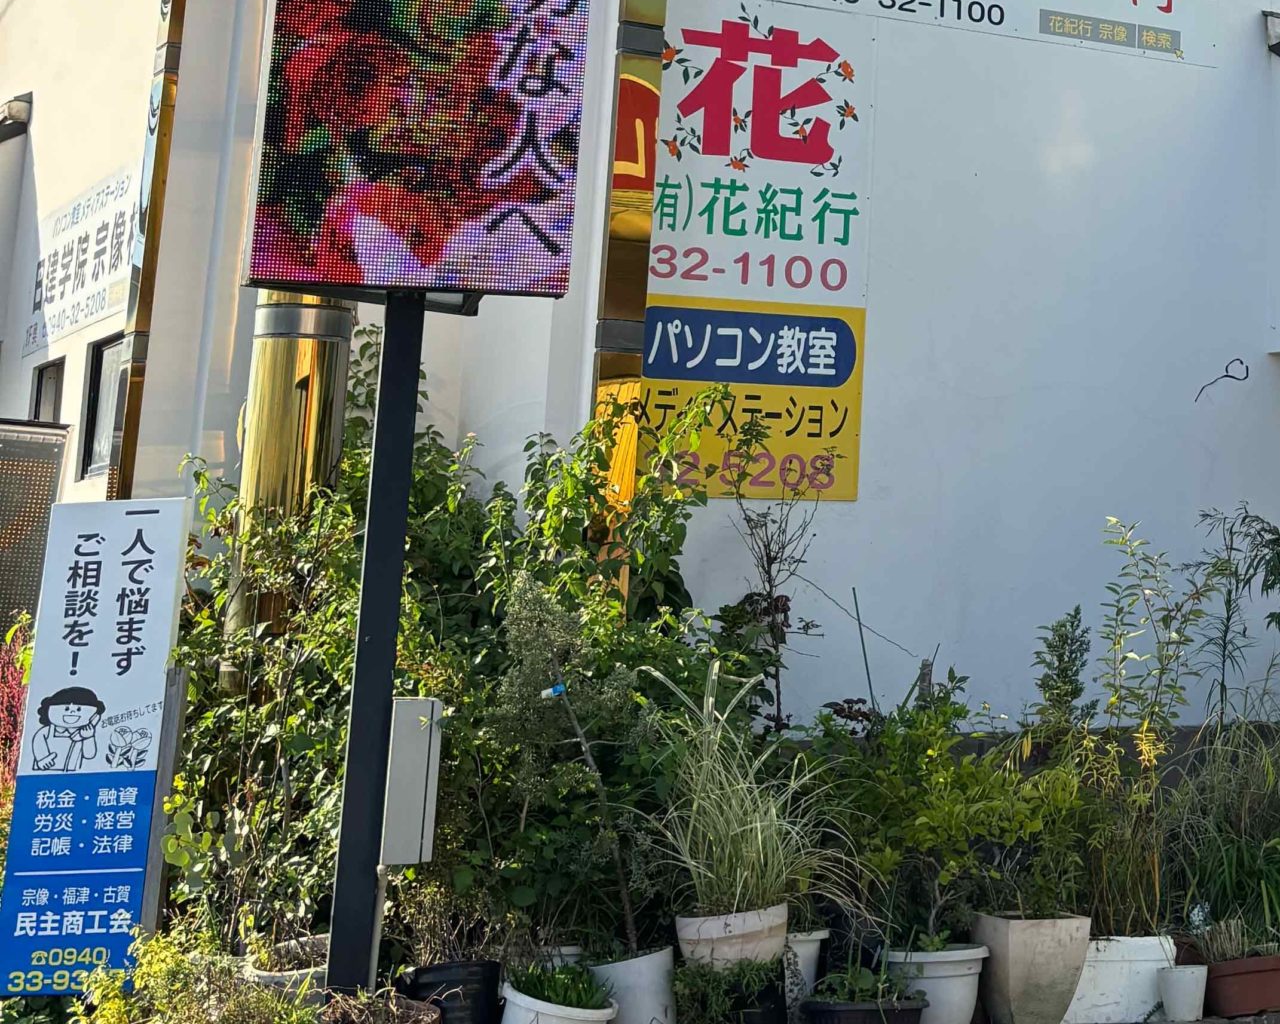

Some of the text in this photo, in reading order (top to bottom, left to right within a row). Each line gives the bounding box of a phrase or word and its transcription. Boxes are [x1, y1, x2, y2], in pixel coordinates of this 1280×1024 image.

[1047, 14, 1172, 50] 花紀行 宗像 検索
[676, 19, 841, 165] 花
[33, 230, 91, 315] 日建学院
[647, 319, 838, 376] パソコン教室
[61, 531, 107, 677] ご相談を!
[111, 508, 161, 677] 一人で悩まず
[35, 786, 139, 809] 税金・融資
[33, 810, 135, 833] 労災・経営
[30, 833, 134, 856] 記帳・法律
[21, 885, 131, 906] 宗像・福津・古賀
[13, 908, 133, 937] 民主商工会
[6, 968, 125, 993] 33-93
